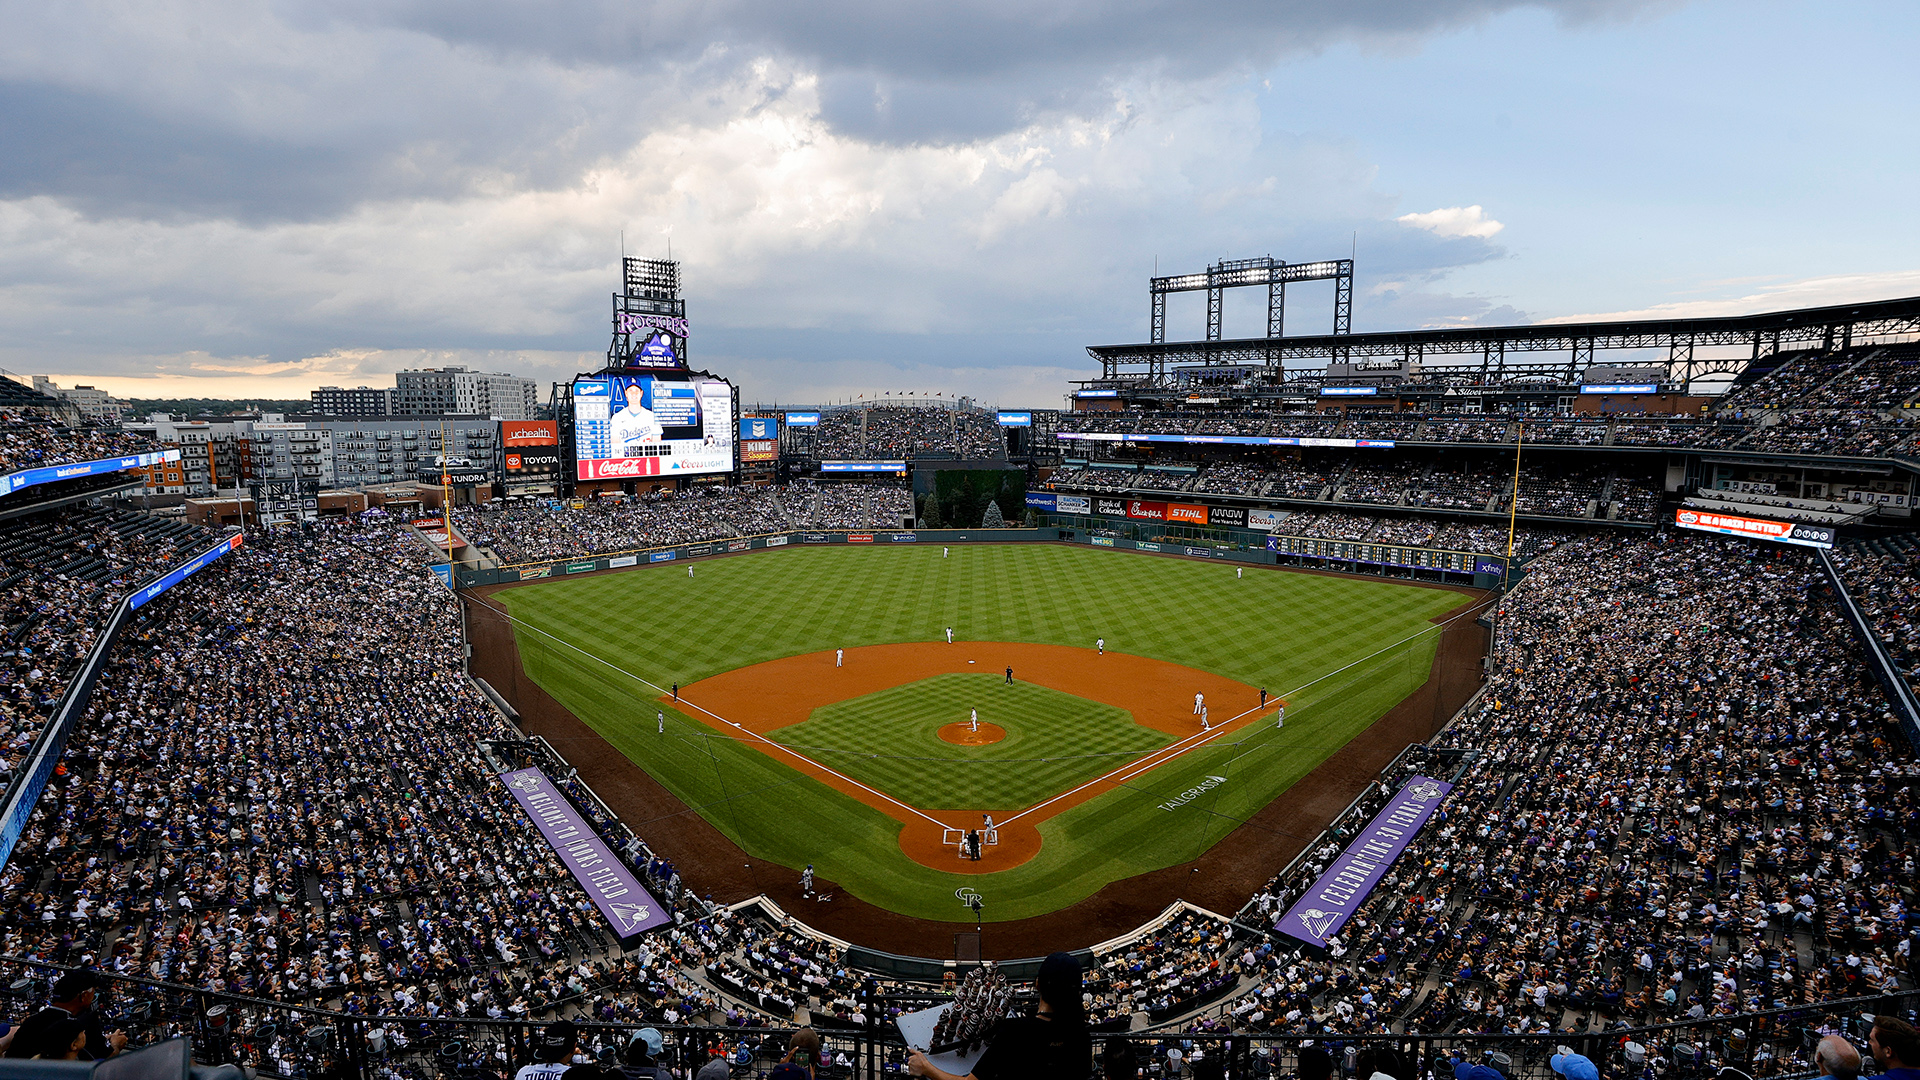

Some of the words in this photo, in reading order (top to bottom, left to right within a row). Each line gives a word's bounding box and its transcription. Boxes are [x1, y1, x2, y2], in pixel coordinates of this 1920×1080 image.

[618, 313, 690, 338] ROCKIES
[1457, 388, 1482, 396] Silver
[1600, 398, 1646, 412] Coors
[510, 427, 551, 438] uchealth
[619, 426, 651, 441] Dodgers
[747, 441, 772, 452] KING
[523, 456, 558, 465] TOYOTA
[681, 459, 703, 469] Coors
[704, 460, 724, 468] LIGHT
[598, 459, 641, 476] Coca-Cola
[451, 474, 486, 483] TUNDRA
[1025, 497, 1053, 506] Southwest
[1098, 506, 1127, 516] Colorado
[1172, 508, 1203, 519] STIHL
[413, 518, 444, 527] uchealth
[1249, 514, 1272, 525] Coors
[1700, 515, 1711, 524] BE
[1711, 516, 1719, 525] A
[1719, 517, 1744, 528] HAIR
[1745, 520, 1782, 533] BETTER
[1092, 538, 1114, 546] bet365
[1481, 563, 1502, 574] xfinity
[527, 791, 569, 828] WELCOME
[1387, 801, 1425, 828] YEARS
[554, 825, 580, 841] TO
[1376, 825, 1404, 842] 30
[564, 839, 603, 868] COORS
[1319, 838, 1394, 907] CELEBRATING
[588, 867, 629, 899] FIELD
[525, 1072, 562, 1080] TURNE
